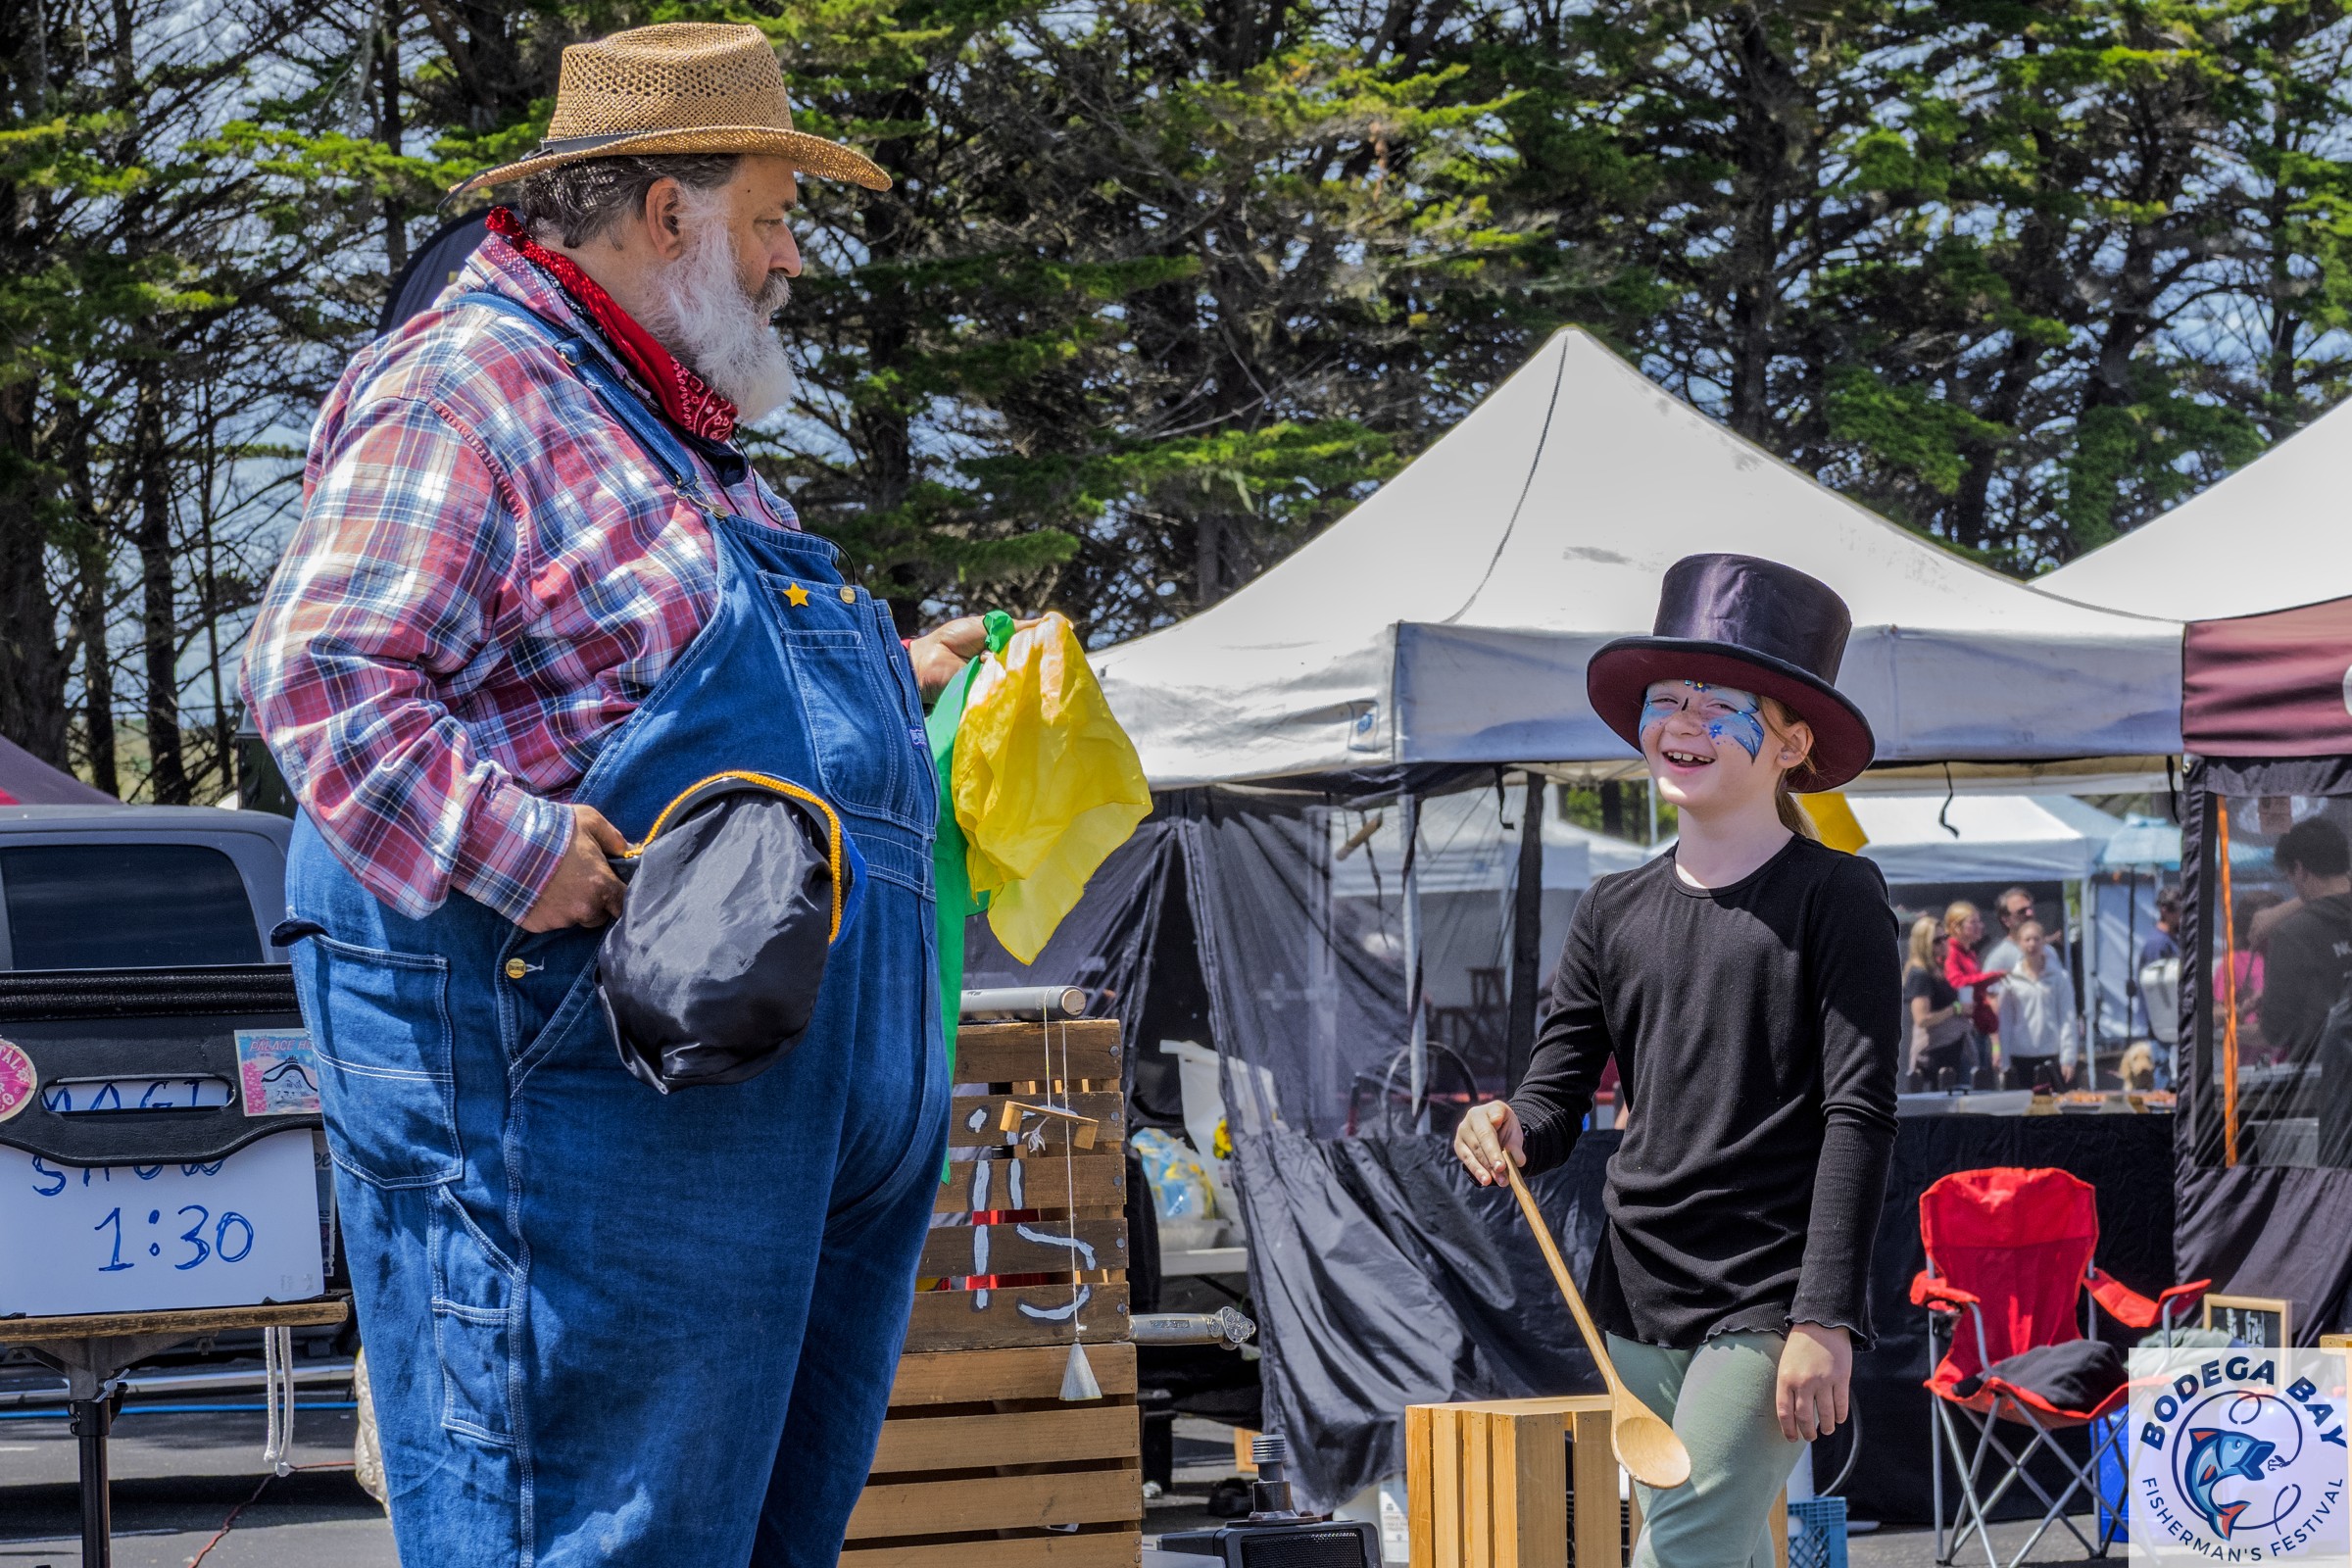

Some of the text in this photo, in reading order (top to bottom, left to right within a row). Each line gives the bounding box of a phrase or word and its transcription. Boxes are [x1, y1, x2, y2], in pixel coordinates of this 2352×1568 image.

[249, 1039, 295, 1052] PALACE
[42, 1080, 236, 1110] MAGI
[95, 1204, 254, 1271] 1:30
